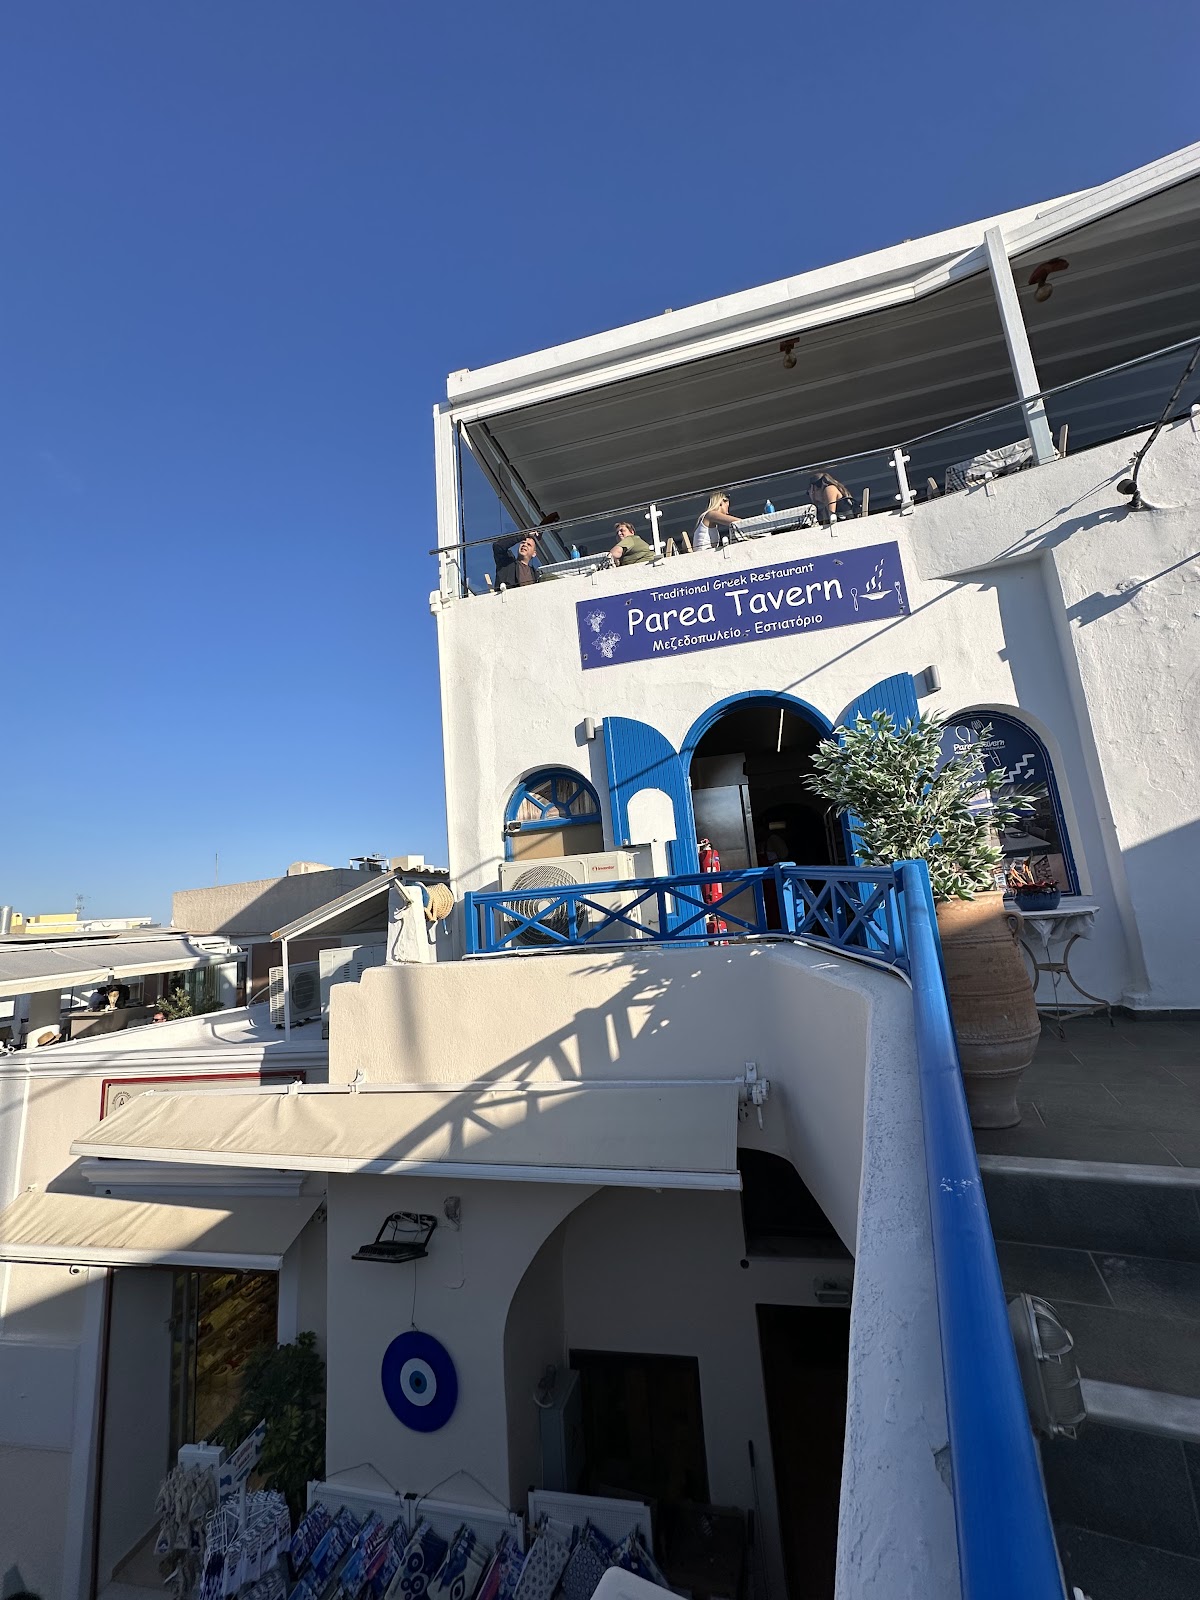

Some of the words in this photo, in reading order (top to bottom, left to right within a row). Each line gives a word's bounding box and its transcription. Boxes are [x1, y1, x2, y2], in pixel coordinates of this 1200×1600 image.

[650, 581, 710, 601] Traditional
[713, 575, 748, 590] Greek
[749, 562, 815, 583] Restaurant
[627, 603, 716, 636] Parea
[724, 579, 844, 617] Tavern
[652, 627, 741, 652] Μεζεδοπωλείο
[754, 614, 824, 634] Εστιατόριο
[953, 743, 974, 752] Pare
